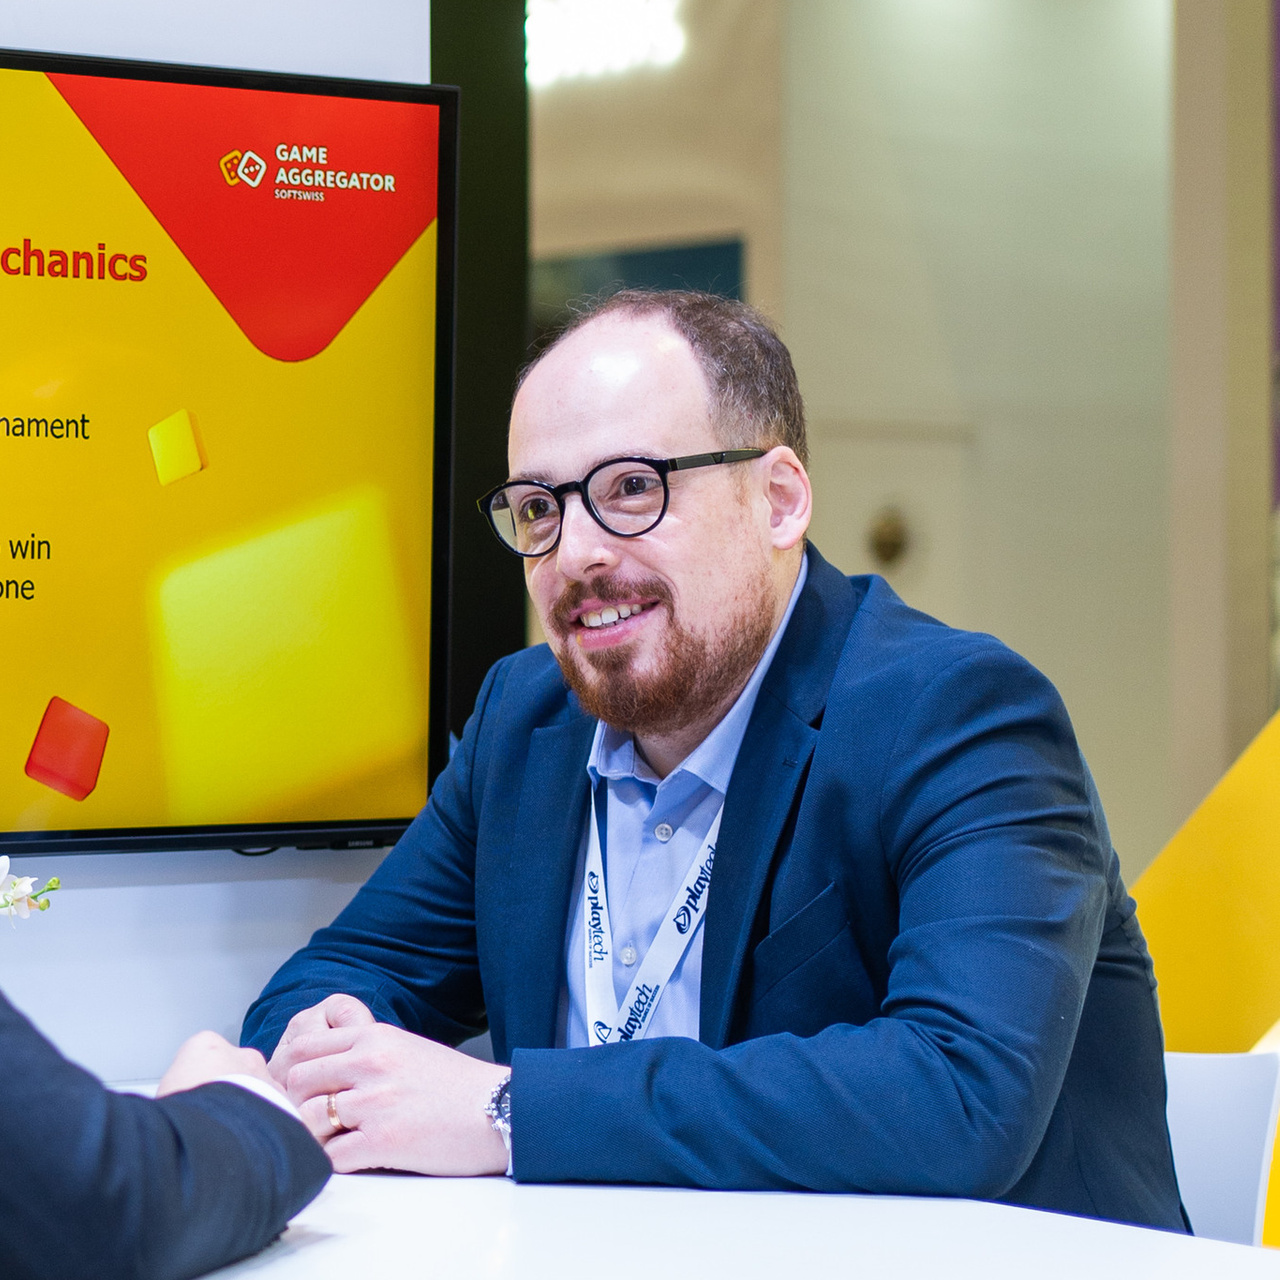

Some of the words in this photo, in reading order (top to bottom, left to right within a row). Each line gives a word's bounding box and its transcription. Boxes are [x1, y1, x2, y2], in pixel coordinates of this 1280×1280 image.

[276, 144, 327, 164] GAME
[275, 167, 395, 192] AGGREGATOR
[274, 188, 325, 202] SOFTSWISS
[8, 533, 51, 560] win
[588, 895, 608, 961] playtech
